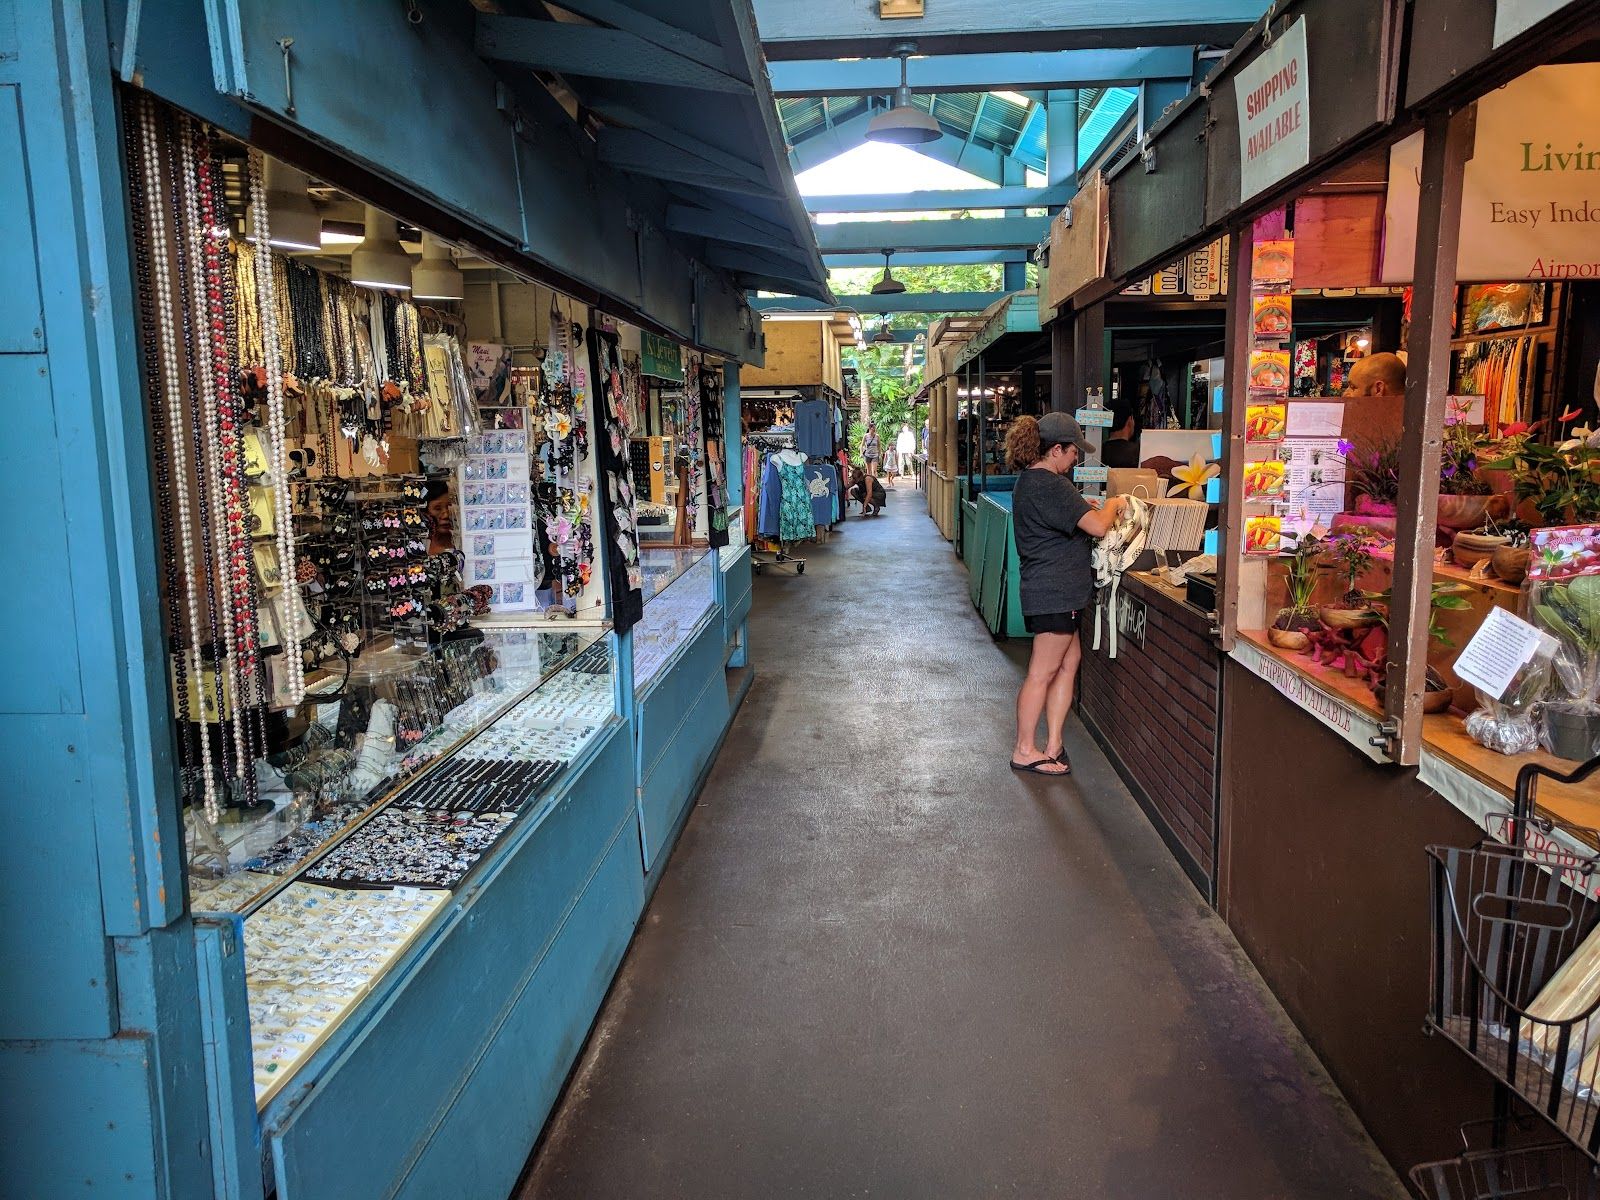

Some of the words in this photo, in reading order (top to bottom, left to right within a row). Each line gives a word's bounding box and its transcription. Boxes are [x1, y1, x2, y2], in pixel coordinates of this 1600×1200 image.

[1246, 57, 1298, 121] SHIPPING
[1247, 101, 1302, 161] AVAILABLE
[1489, 202, 1542, 229] Easy
[1193, 244, 1209, 290] E6959
[1258, 655, 1297, 695] SHIPPING
[1295, 682, 1351, 733] AVAILABLE
